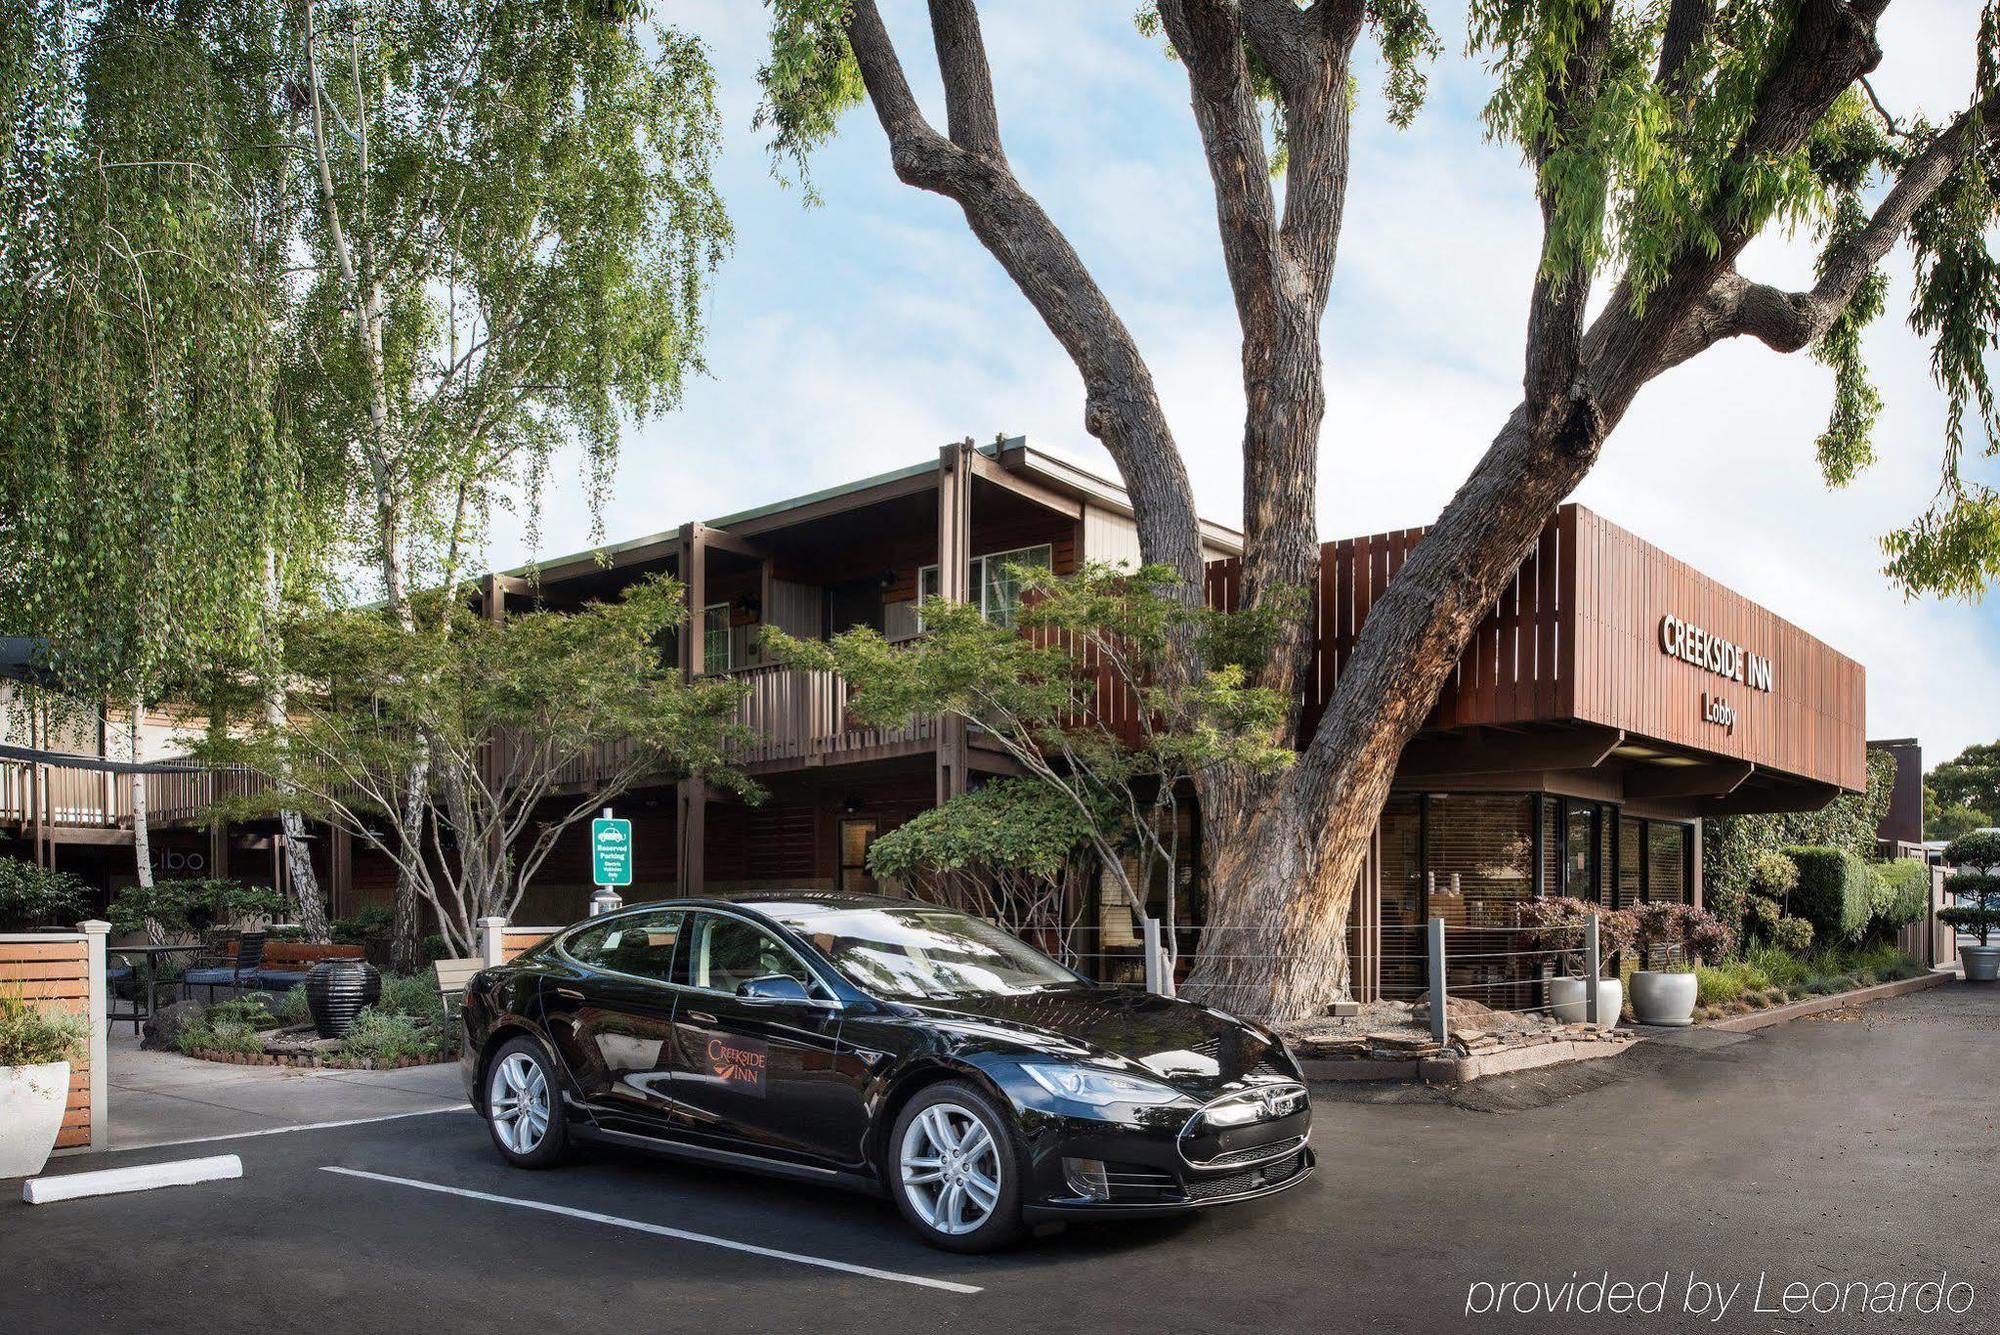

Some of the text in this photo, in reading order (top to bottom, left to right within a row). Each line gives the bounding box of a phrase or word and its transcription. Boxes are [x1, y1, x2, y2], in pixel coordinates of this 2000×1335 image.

[1659, 614, 1772, 693] CREEKSIDE INN
[1702, 691, 1737, 736] Lobby
[600, 852, 625, 861] Parking
[707, 1039, 766, 1068] CREEKSIDE
[734, 1065, 758, 1083] INN
